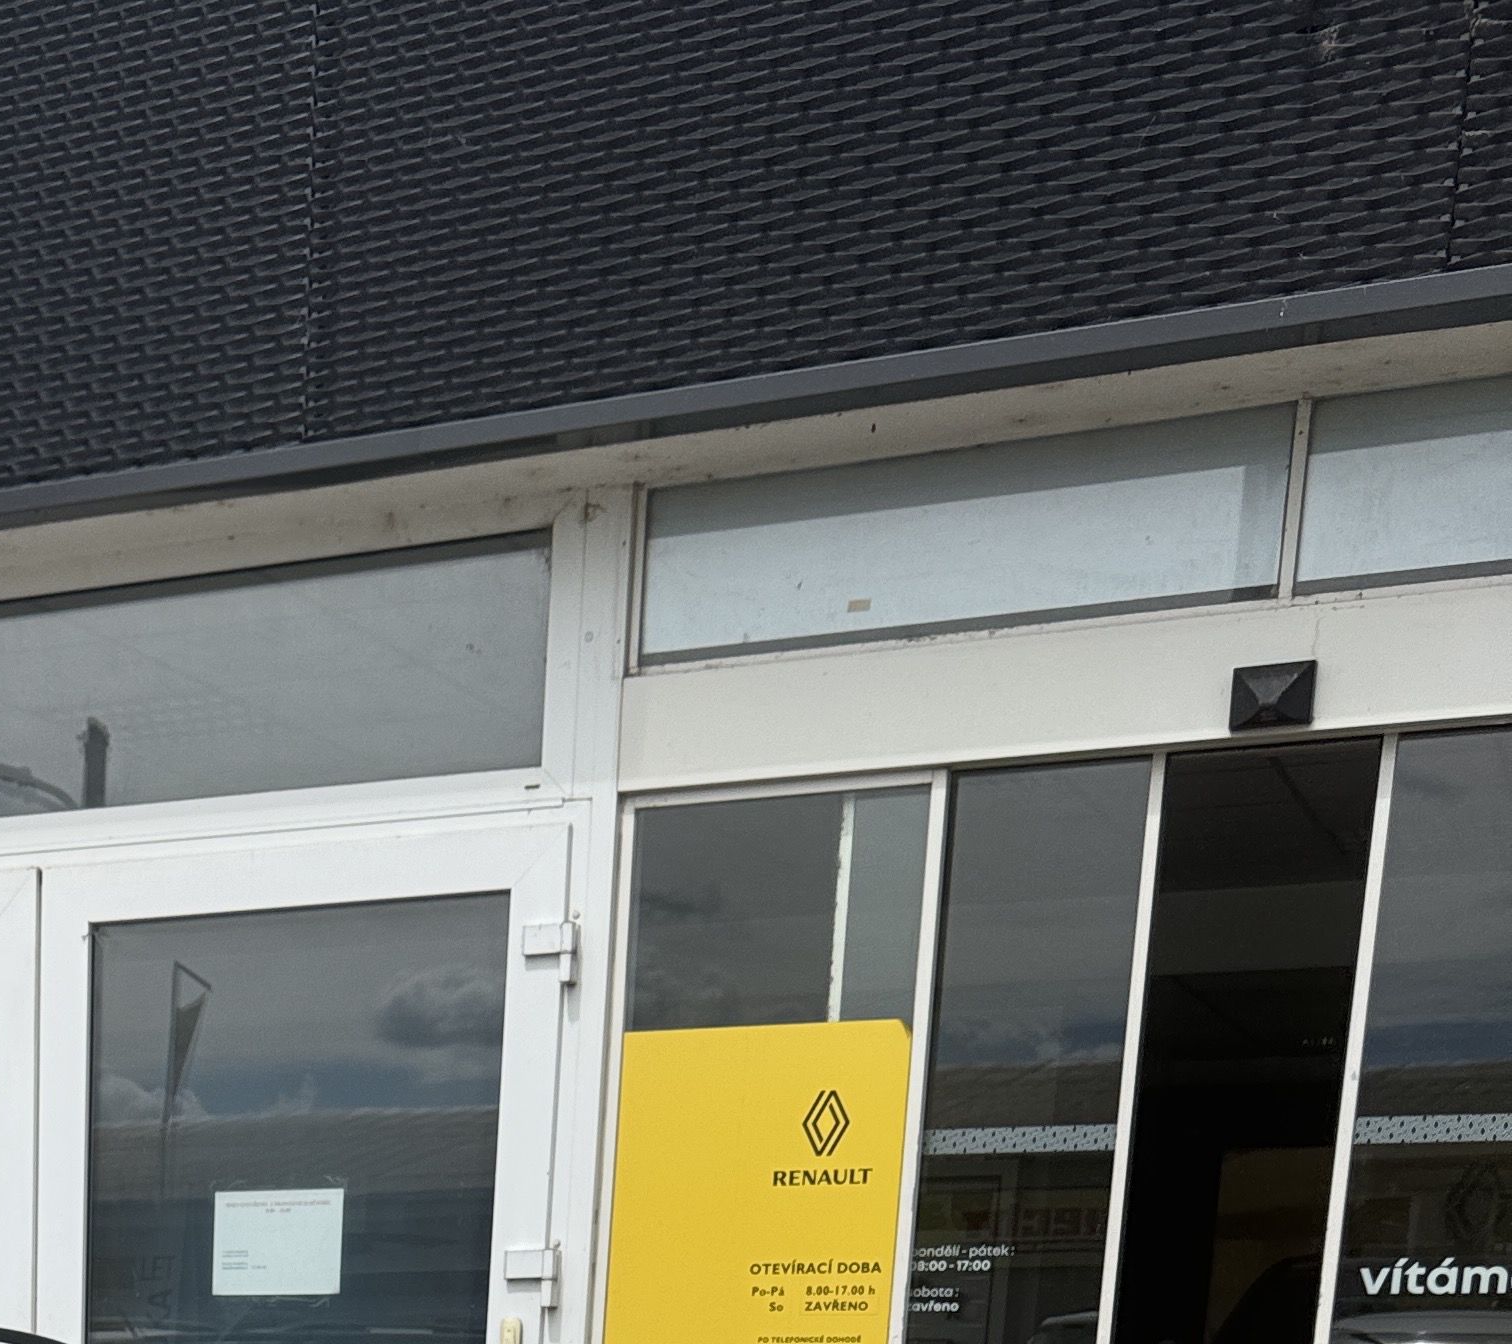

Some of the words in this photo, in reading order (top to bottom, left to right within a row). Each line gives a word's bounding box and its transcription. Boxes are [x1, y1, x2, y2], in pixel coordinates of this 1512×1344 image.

[772, 1167, 873, 1187] RENAULT
[749, 1258, 834, 1275] OTEVÍRACÍ
[837, 1261, 882, 1274] DOBA
[956, 1259, 992, 1272] 17:00
[1359, 1256, 1512, 1296] vítám
[751, 1285, 785, 1297] Po-Pá
[909, 1285, 960, 1298] obota:
[768, 1301, 784, 1312] So
[804, 1298, 869, 1312] ZAVŘENO
